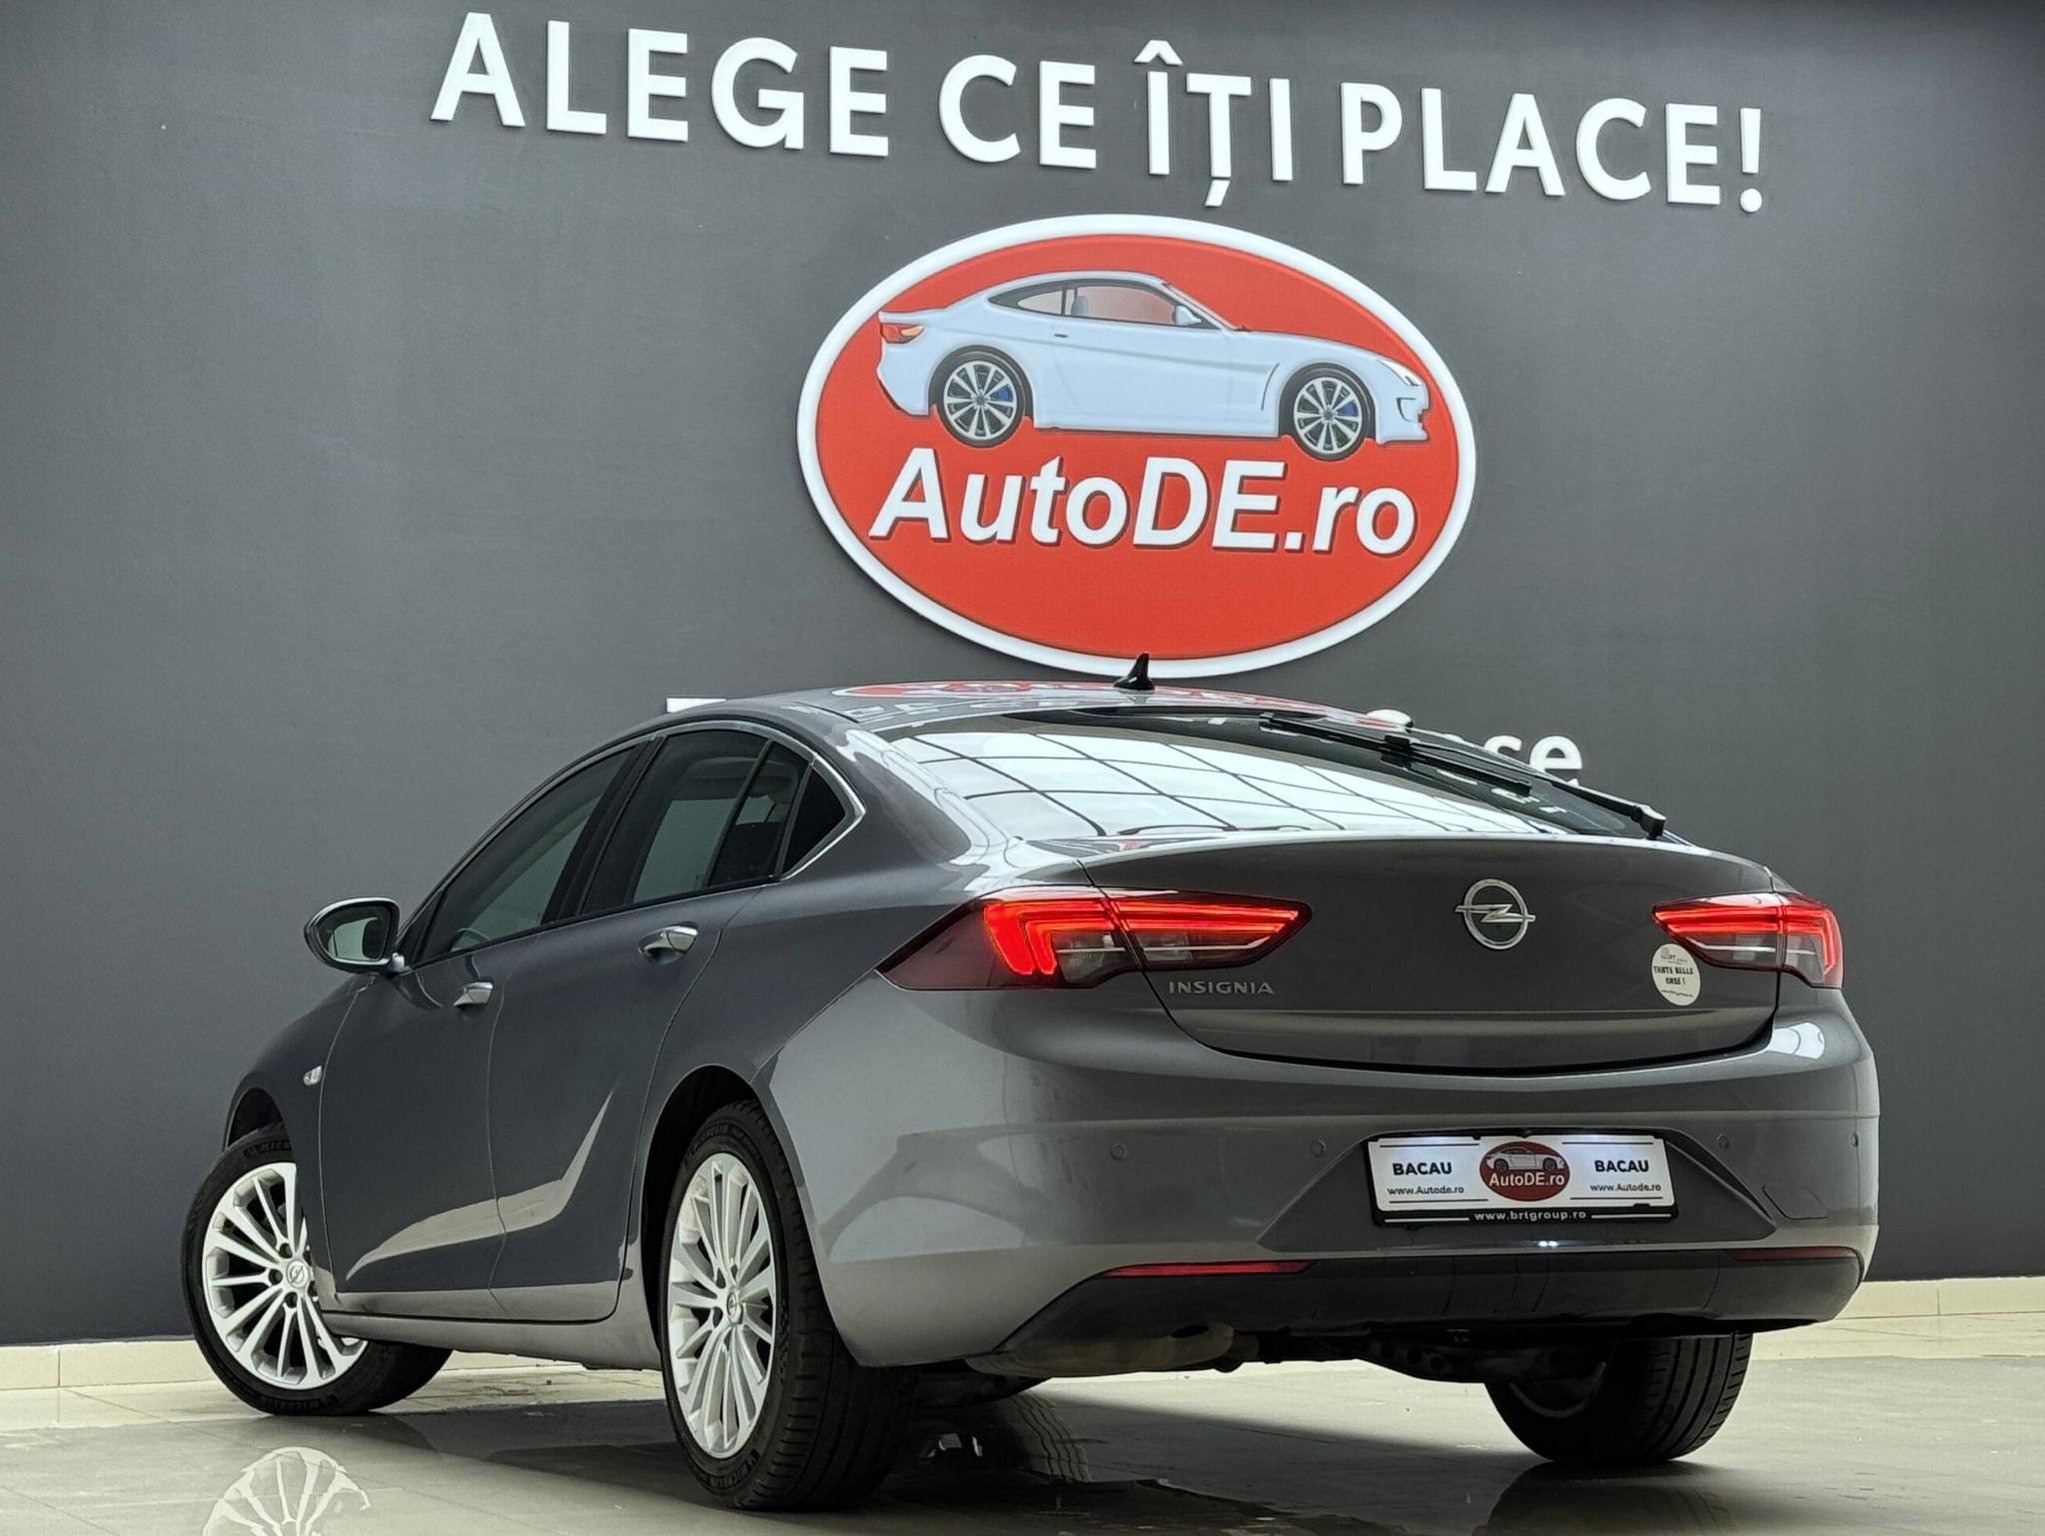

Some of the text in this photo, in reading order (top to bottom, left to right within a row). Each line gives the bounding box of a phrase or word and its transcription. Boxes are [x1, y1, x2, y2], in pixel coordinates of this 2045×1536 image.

[430, 12, 889, 157] ALEGE
[938, 54, 1097, 169] CE
[1340, 82, 1763, 213] PLACE!
[869, 447, 1417, 556] AutoDE.ro
[1168, 981, 1275, 995] INSIGNIA
[1392, 1162, 1453, 1176] BACAU
[1594, 1159, 1650, 1173] BACAU
[1488, 1171, 1566, 1187] AutoDE.ro
[1386, 1185, 1465, 1196] www.Autode.ro
[1589, 1182, 1662, 1192] www.Autode.ro
